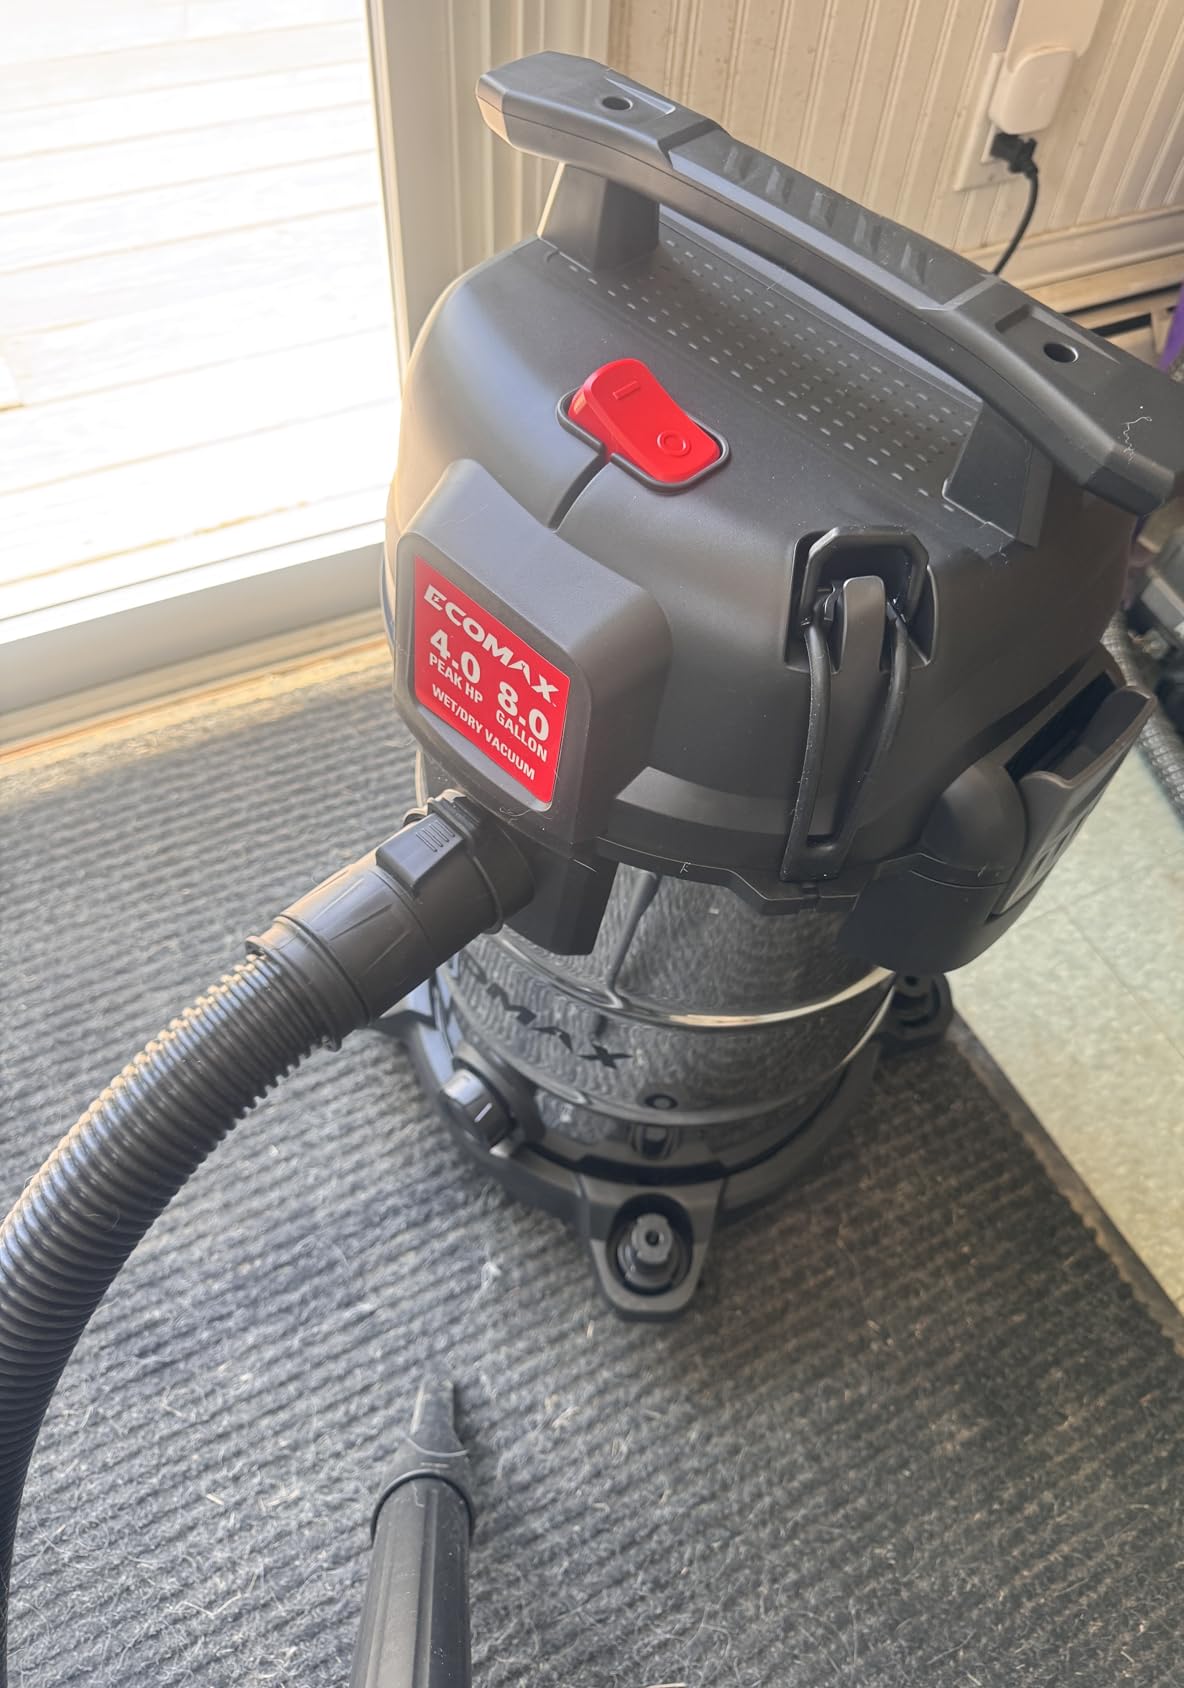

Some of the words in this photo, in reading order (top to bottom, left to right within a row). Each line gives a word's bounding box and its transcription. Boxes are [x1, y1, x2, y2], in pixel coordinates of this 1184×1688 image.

[424, 584, 559, 703] ECOMAX
[430, 629, 481, 684] 4.0
[429, 652, 463, 690] PEAK
[465, 682, 484, 703] HP
[432, 683, 483, 733] WET/DRY
[485, 728, 535, 780] VACUUM
[496, 709, 548, 762] GALLON
[497, 681, 549, 741] 8.0
